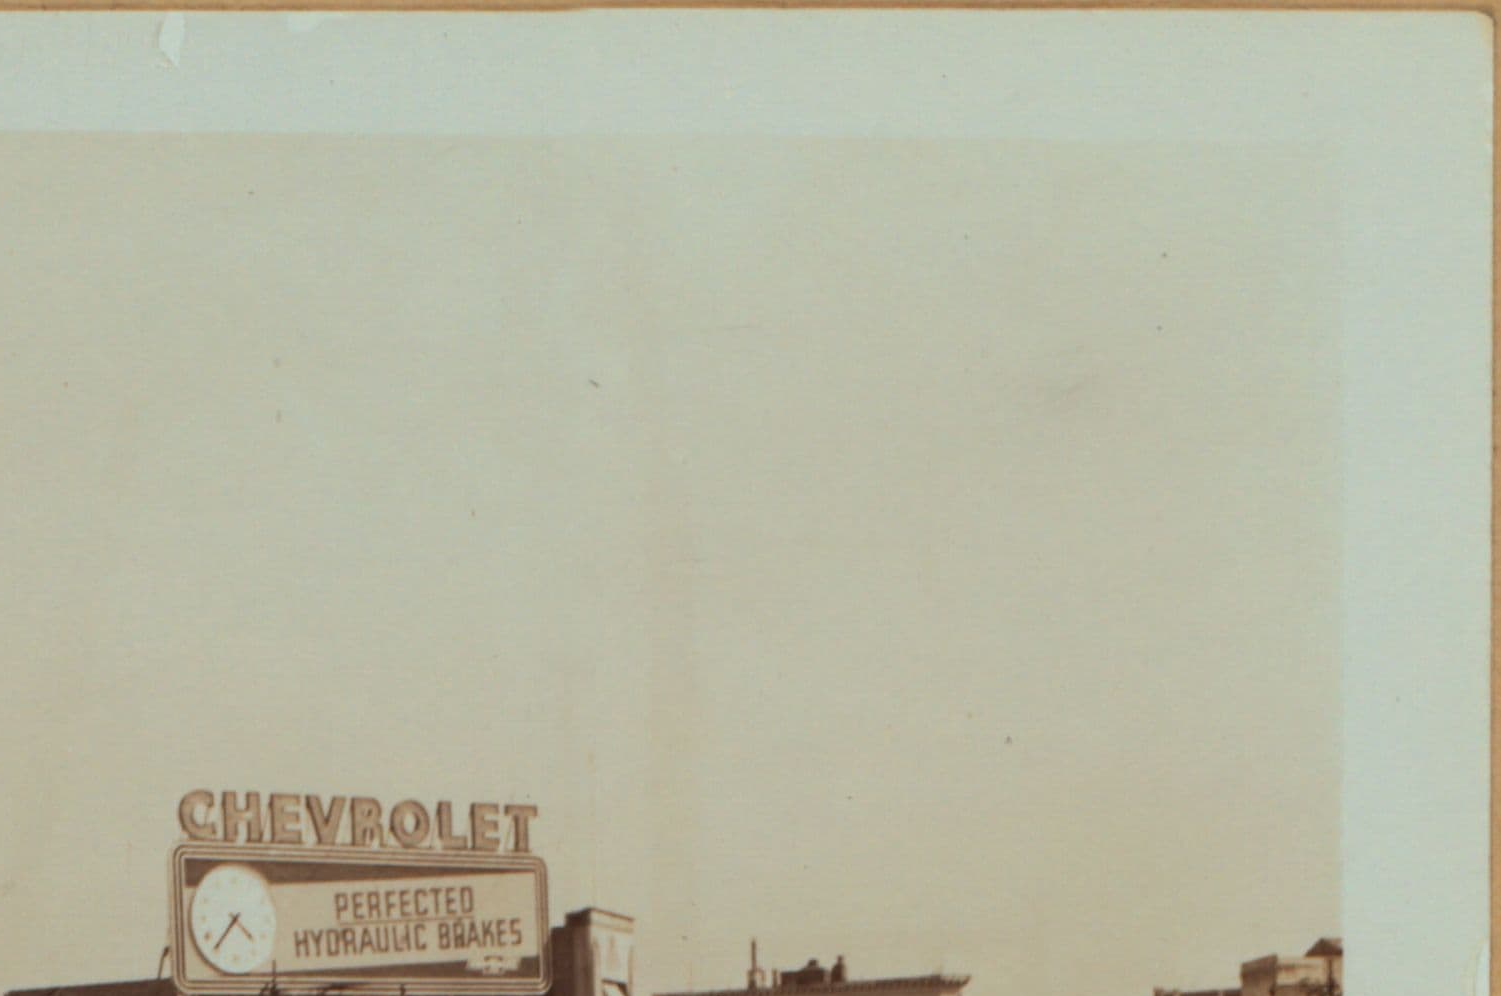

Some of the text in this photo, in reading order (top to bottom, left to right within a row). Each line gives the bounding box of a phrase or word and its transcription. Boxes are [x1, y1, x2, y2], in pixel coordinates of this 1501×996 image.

[177, 788, 539, 853] CHEVROLET
[333, 885, 476, 920] PERFECTED
[293, 917, 524, 959] HYDRAULIC BRAKES
